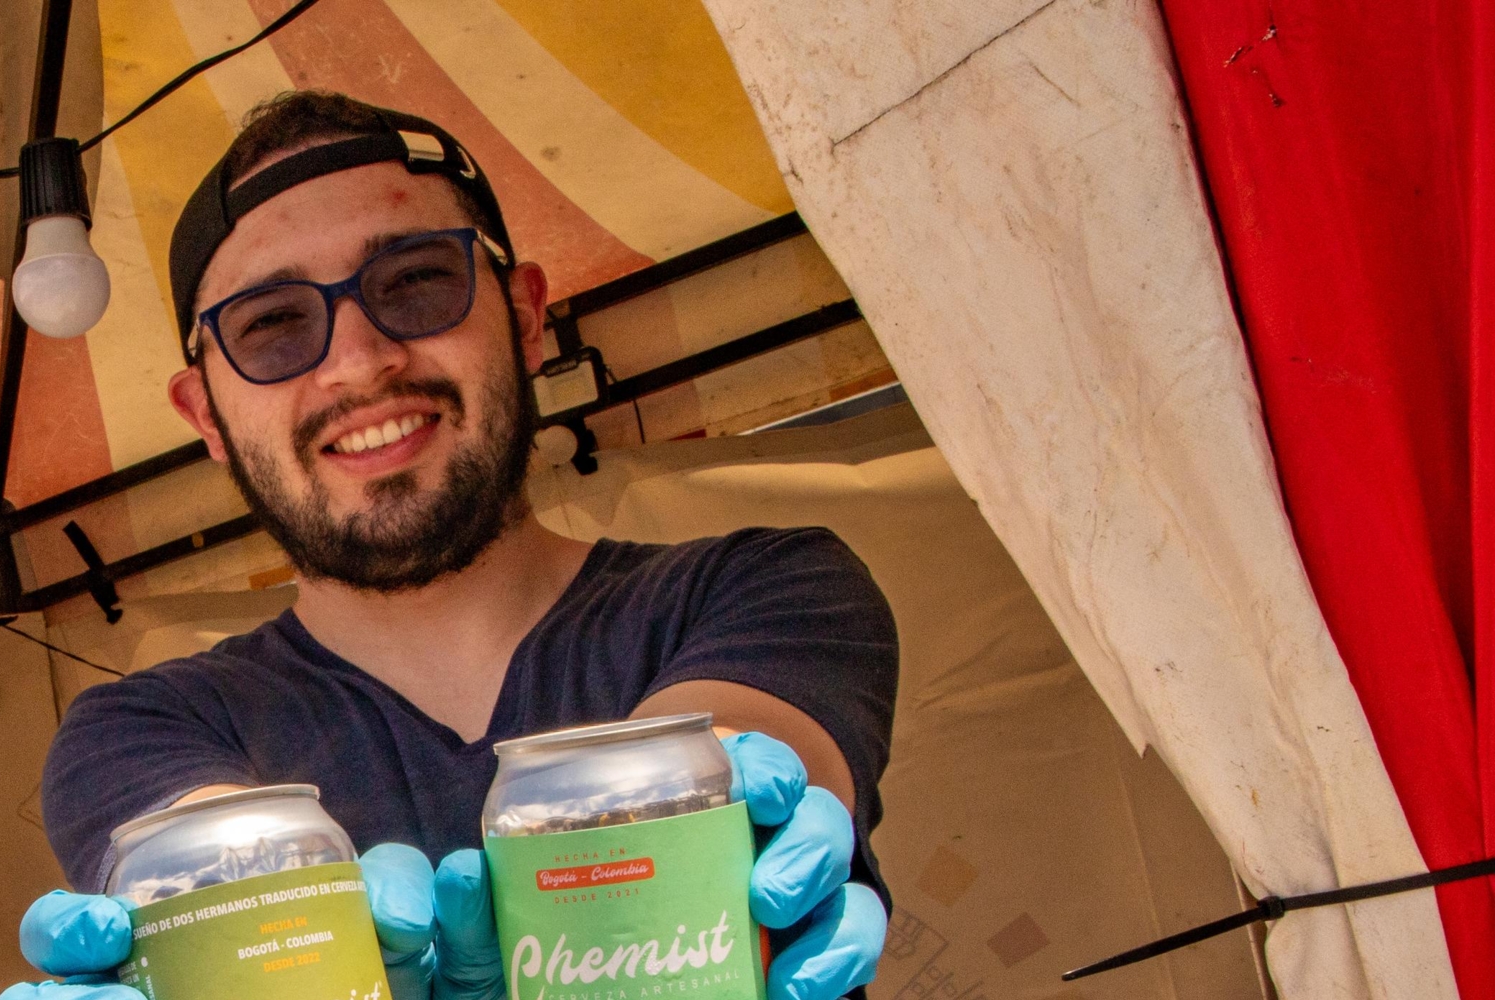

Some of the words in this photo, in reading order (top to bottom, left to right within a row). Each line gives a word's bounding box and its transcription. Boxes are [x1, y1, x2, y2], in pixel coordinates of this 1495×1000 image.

[540, 870, 578, 887] Bogotá
[590, 863, 649, 881] Colombia
[132, 922, 158, 941] SUEÑO
[160, 917, 172, 931] DE
[173, 911, 194, 928] DOS
[196, 897, 258, 922] HERMANOS
[259, 883, 318, 907] TRADUCIDO
[319, 882, 330, 895] EN
[331, 880, 358, 893] CERVEZA
[554, 893, 597, 905] DESDE
[238, 938, 280, 960] BOGOTÁ
[286, 930, 334, 949] COLOMBIA
[263, 953, 295, 973] DESDE
[640, 969, 741, 998] ARTESANAL
